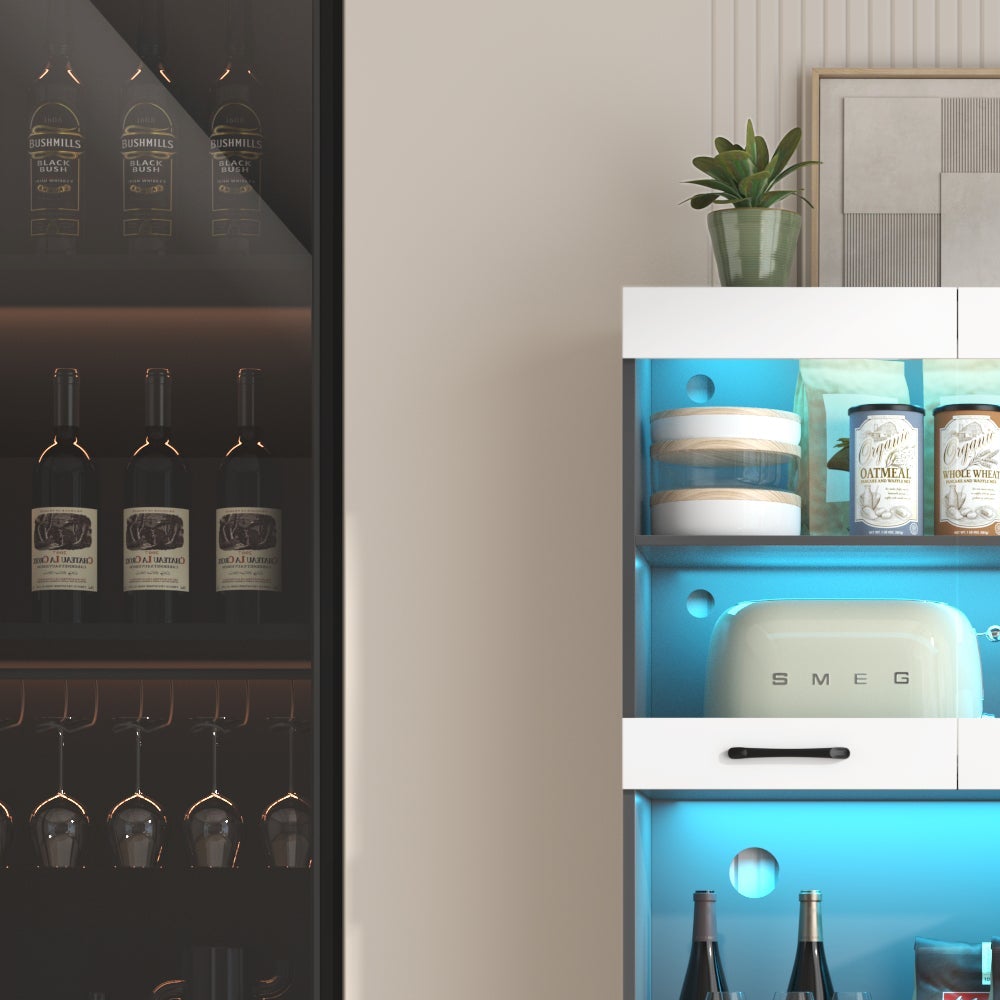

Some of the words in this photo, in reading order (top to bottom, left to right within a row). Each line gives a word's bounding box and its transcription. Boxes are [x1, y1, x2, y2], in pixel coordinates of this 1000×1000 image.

[29, 138, 81, 149] BUSHMILLS
[121, 138, 174, 149] BUSHMILLS
[210, 138, 262, 149] BUSHMILLS
[859, 429, 909, 466] Organic
[943, 429, 994, 466] Organic
[860, 467, 911, 479] OATMEAL
[942, 469, 971, 479] WHOLE
[973, 469, 1000, 479] WHEAT
[771, 671, 910, 686] SMEG
